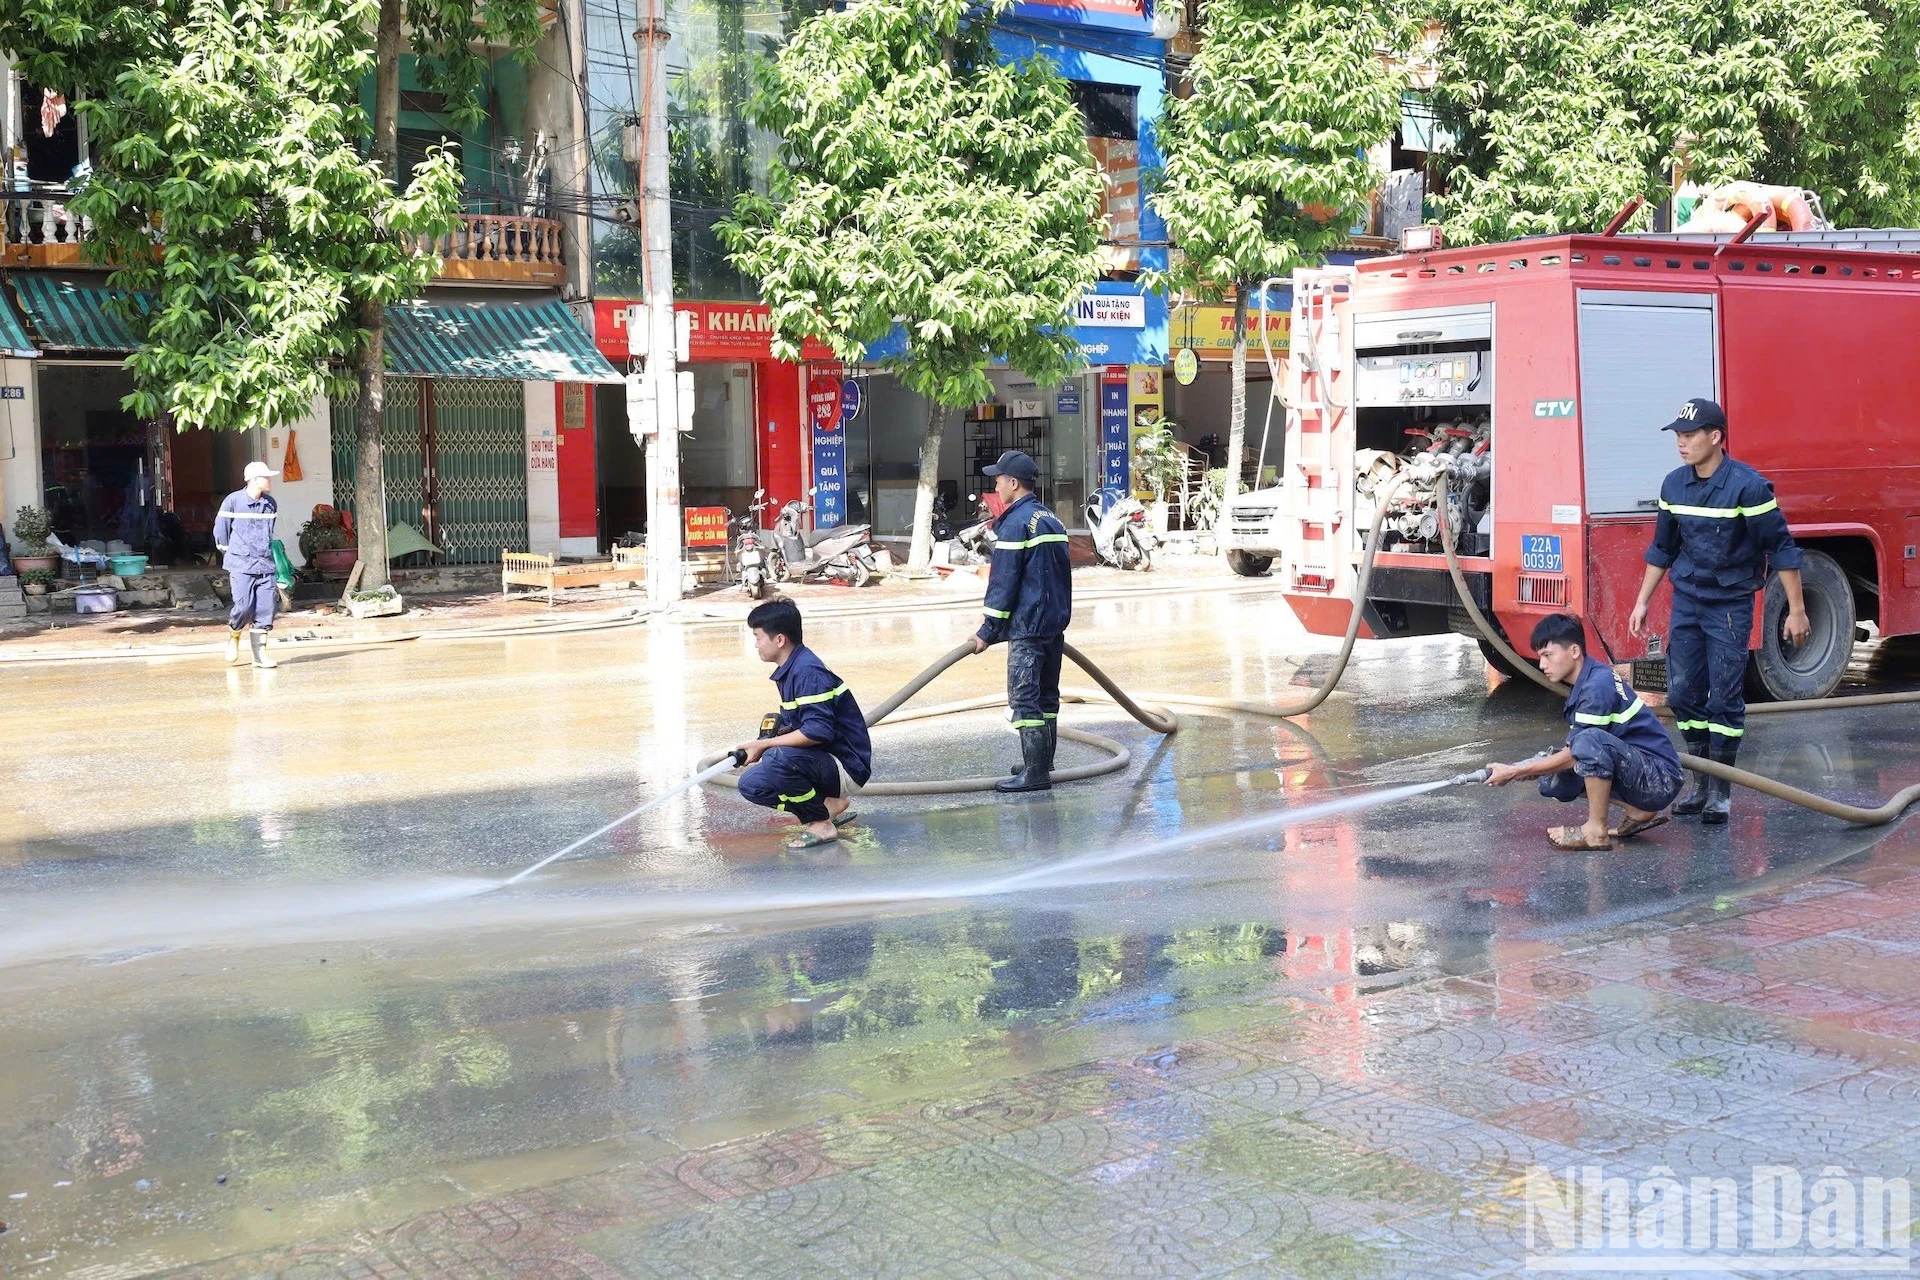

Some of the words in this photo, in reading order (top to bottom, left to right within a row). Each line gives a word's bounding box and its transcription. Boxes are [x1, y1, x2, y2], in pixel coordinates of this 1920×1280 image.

[1096, 298, 1110, 308] QUÀ
[1112, 298, 1130, 309] TẶNG
[1096, 310, 1108, 321] SỰ
[1110, 310, 1130, 322] KIỆN
[1174, 337, 1206, 347] COFFEE
[1080, 342, 1109, 356] NGHIỆP
[4, 389, 21, 398] 286
[1111, 392, 1119, 400] IN
[1534, 401, 1574, 416] CTV
[1111, 424, 1120, 433] KỸ
[531, 440, 541, 452] CHO
[815, 434, 843, 447] NGHIỆP
[542, 455, 554, 468] HÀNG
[1111, 456, 1120, 467] SỐ
[821, 465, 838, 476] QUÀ
[1110, 473, 1122, 484] LẤY
[819, 481, 840, 493] TẶNG
[825, 497, 835, 508] SỰ
[822, 512, 839, 523] KIỆN
[1530, 537, 1551, 552] 22A
[1523, 554, 1560, 570] 003.97
